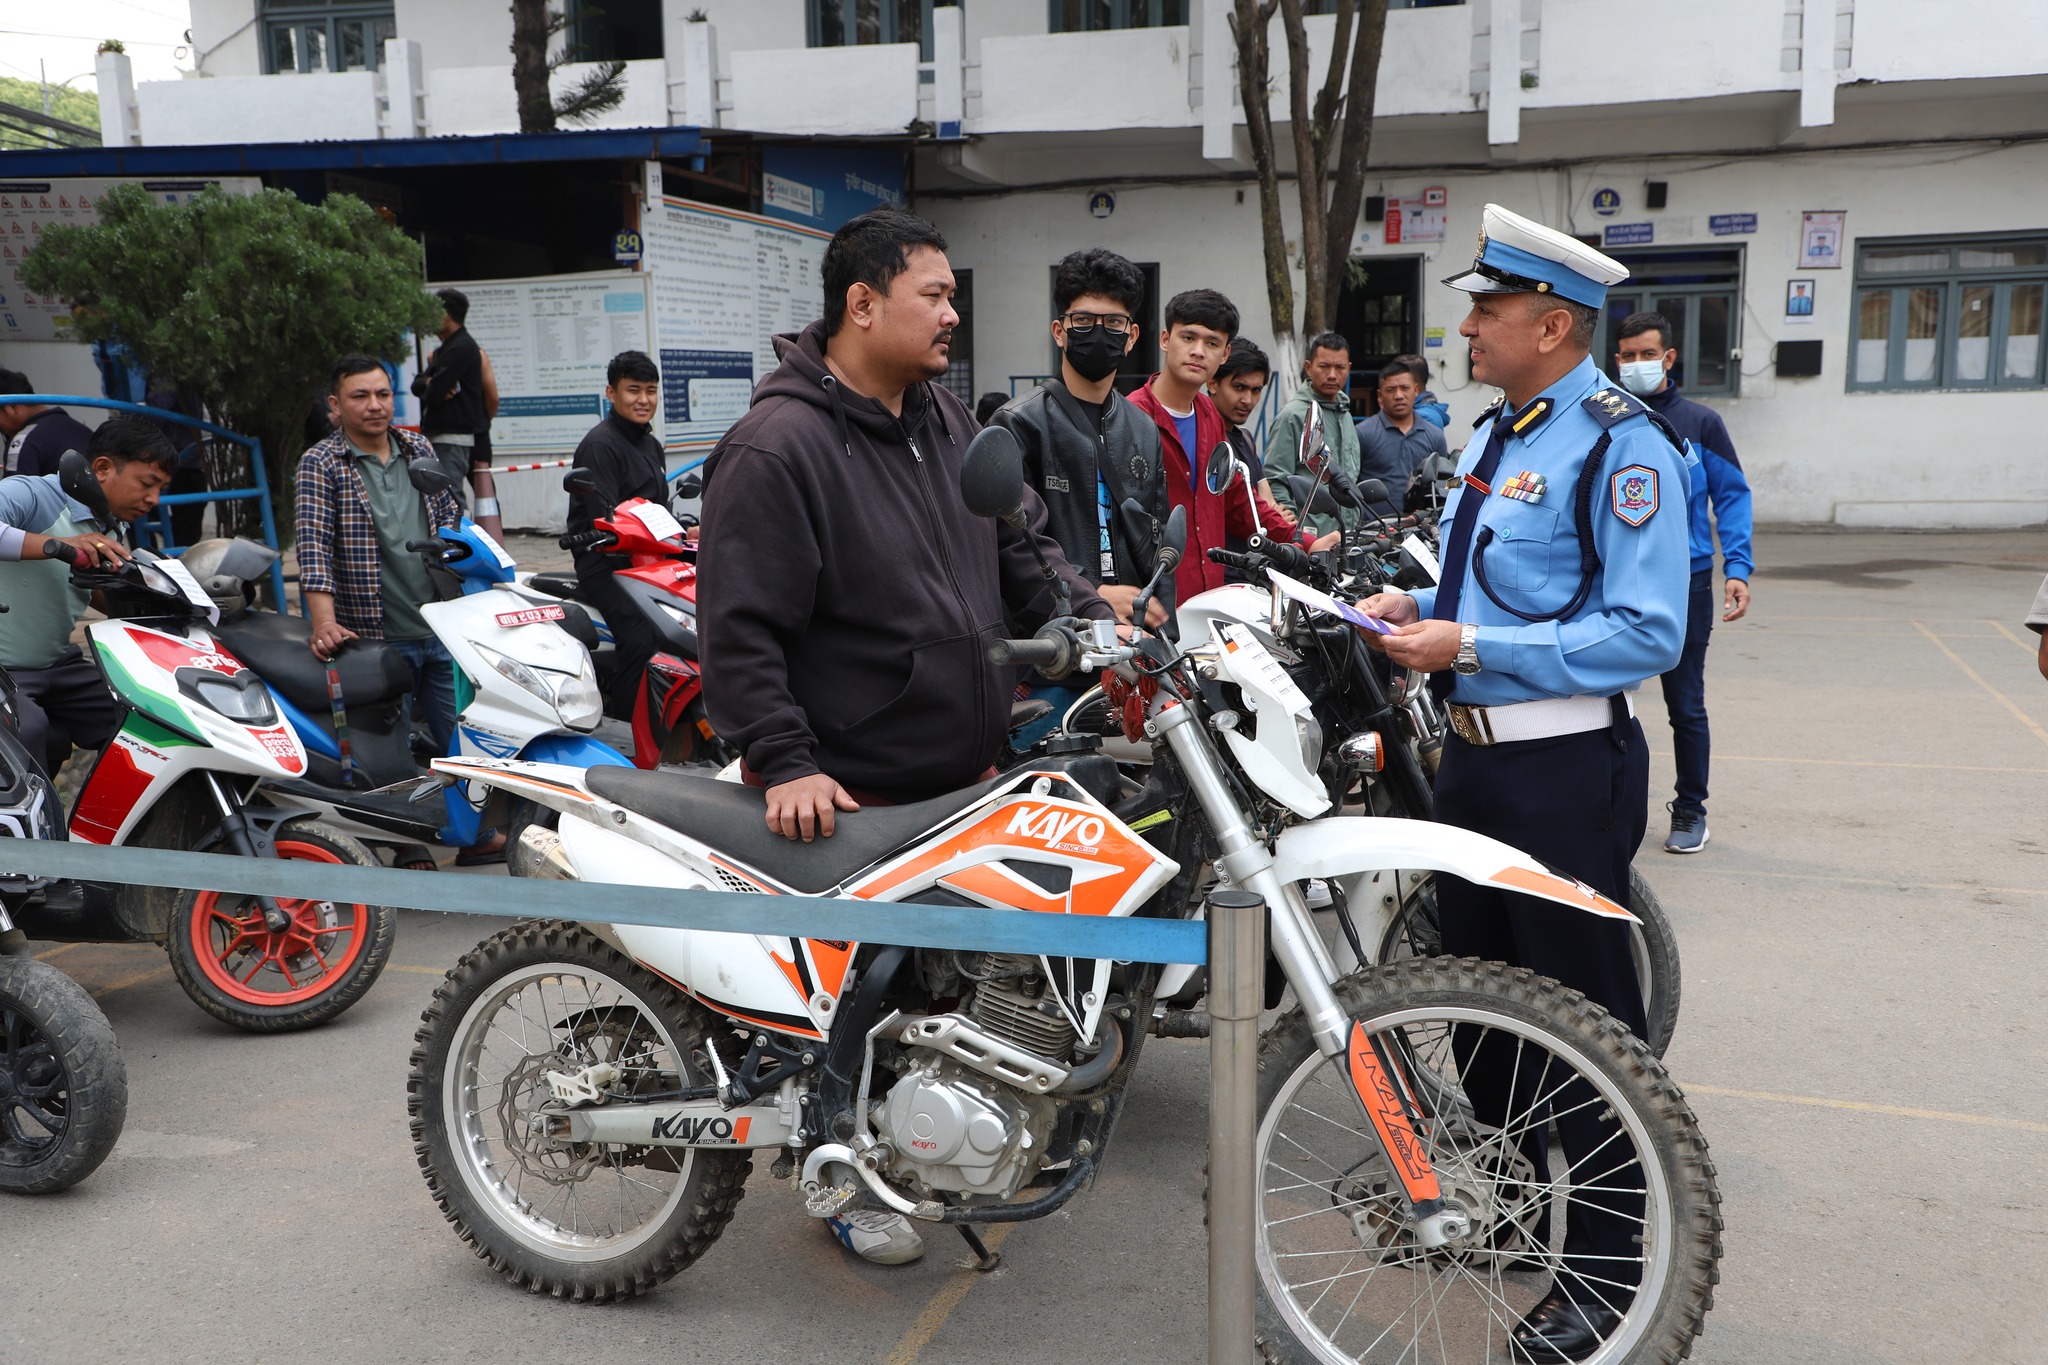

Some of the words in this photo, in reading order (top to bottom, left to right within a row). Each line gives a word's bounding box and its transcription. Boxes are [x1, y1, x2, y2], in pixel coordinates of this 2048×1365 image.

[190, 653, 243, 670] aprilia
[1004, 804, 1105, 849] KAYO
[651, 1109, 733, 1144] KAYO
[911, 1139, 937, 1150] KAYO
[1390, 1129, 1412, 1161] SINCE
